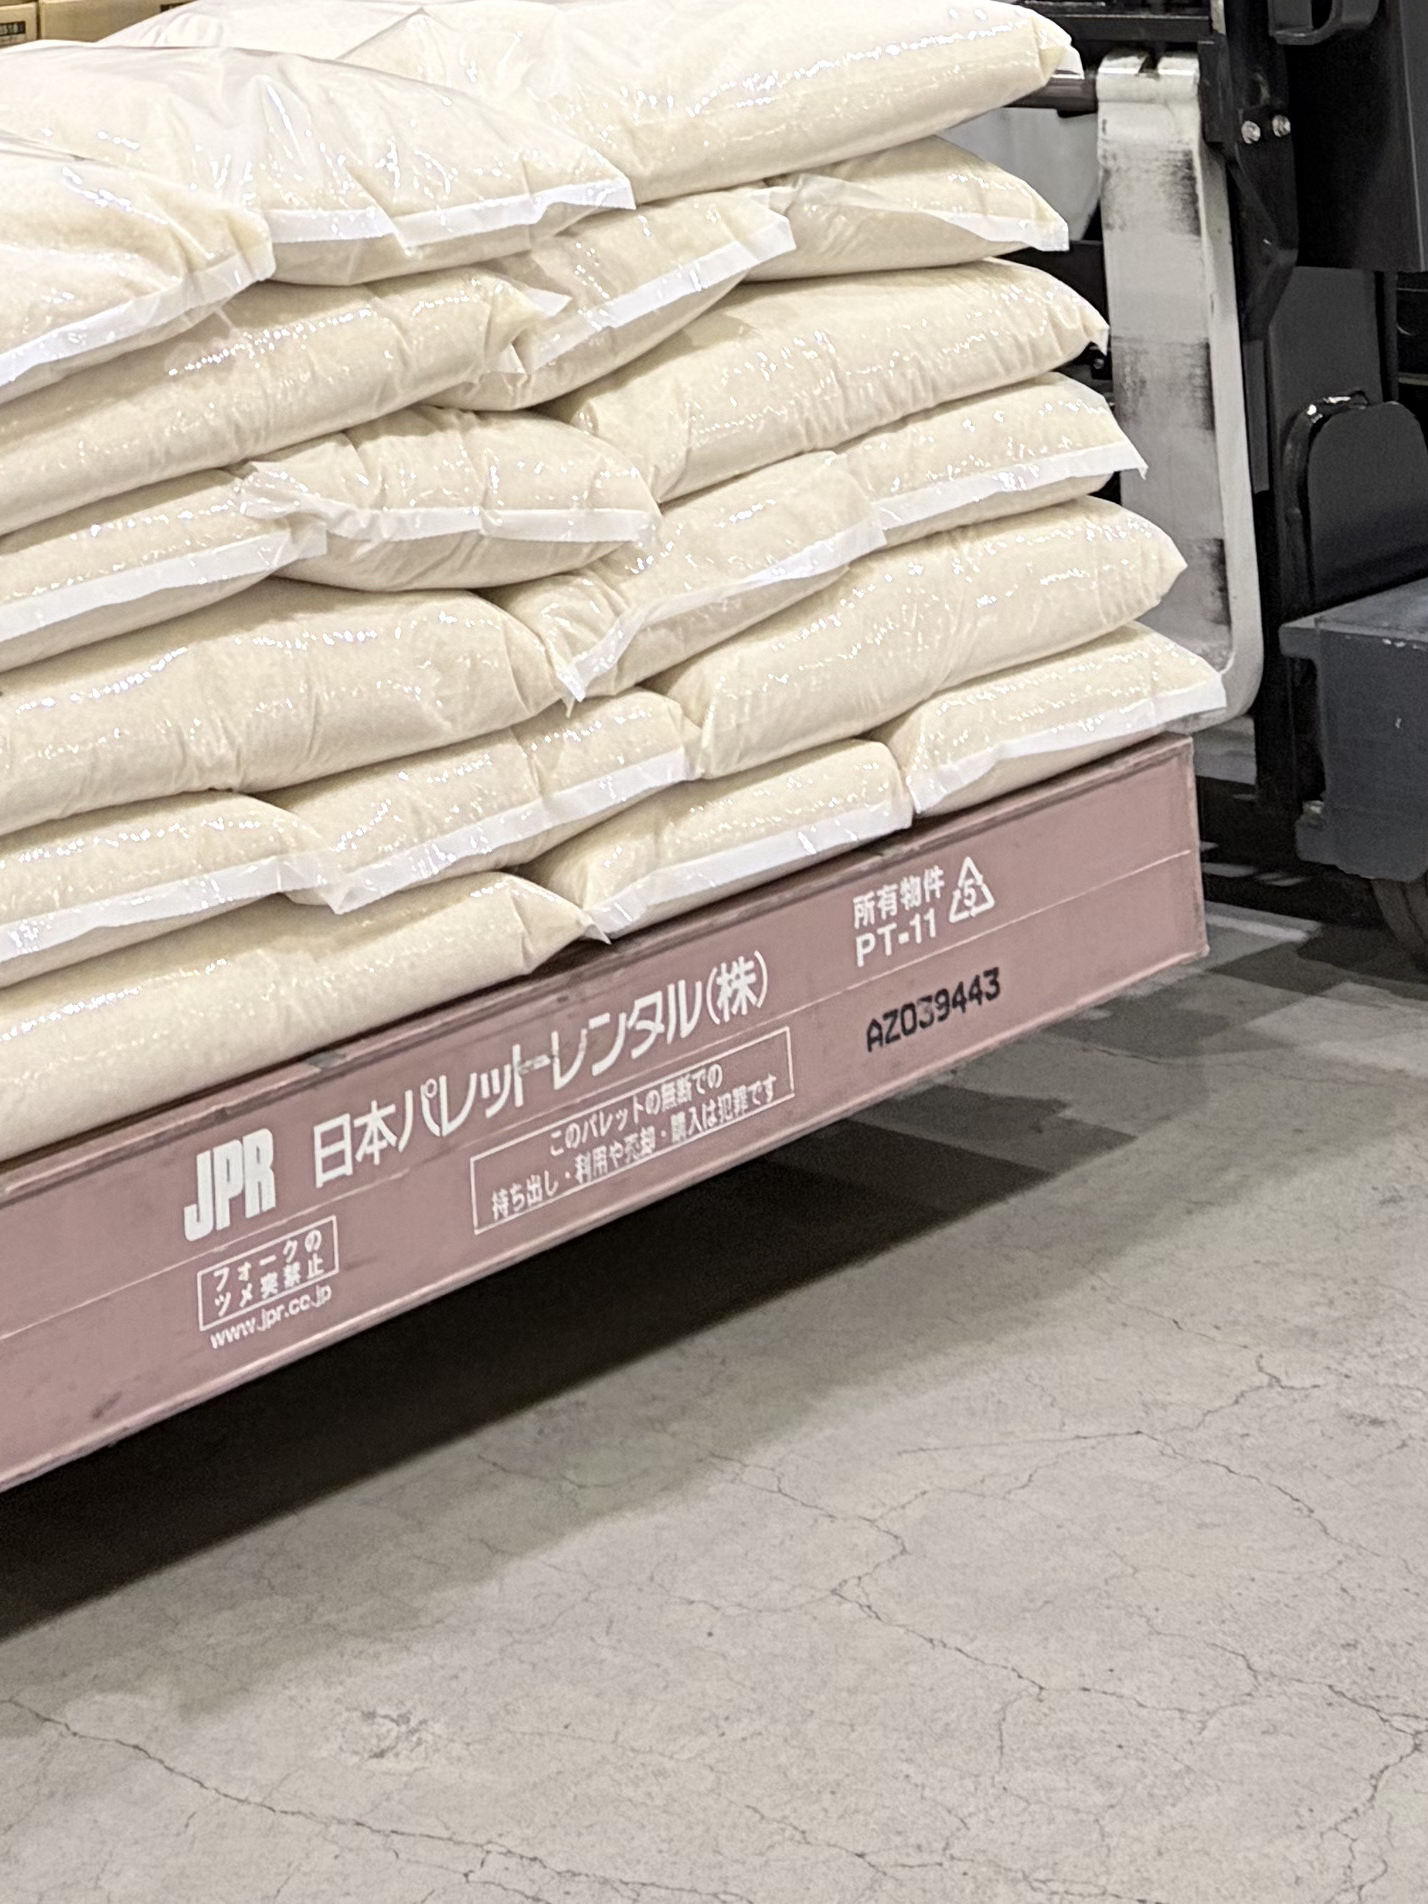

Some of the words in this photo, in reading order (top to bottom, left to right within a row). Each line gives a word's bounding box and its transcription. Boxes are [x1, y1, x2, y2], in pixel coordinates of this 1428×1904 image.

[853, 867, 946, 930] 所有物件
[856, 908, 937, 968] PT-11
[866, 967, 1002, 1053] AZ039443
[184, 1128, 276, 1242] JPR
[313, 950, 769, 1189] 日本パレットレンタル(株)
[549, 1064, 724, 1157] このパレットの無断での
[213, 1229, 323, 1292] フォークの
[210, 1284, 332, 1350] www.jpr.co.jp
